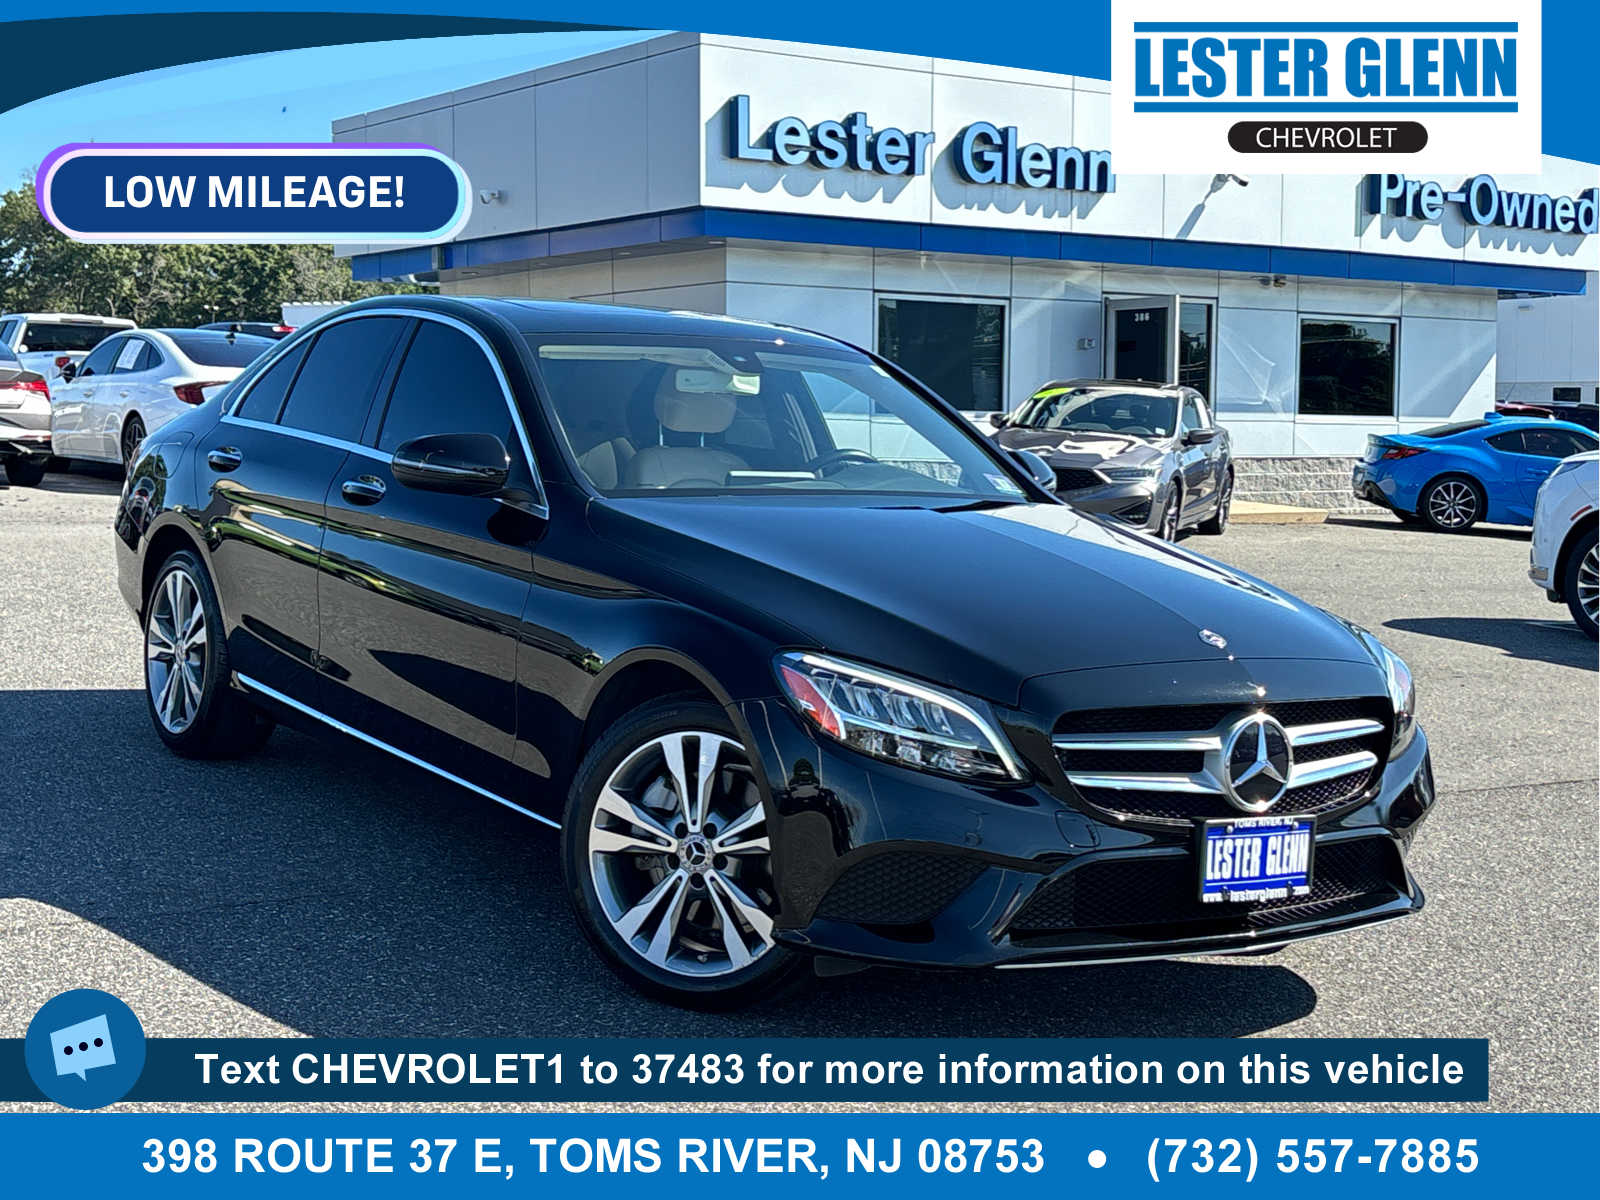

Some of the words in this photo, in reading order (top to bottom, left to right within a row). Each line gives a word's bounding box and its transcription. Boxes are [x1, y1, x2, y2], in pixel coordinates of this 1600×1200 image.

[732, 94, 935, 176] Lester
[956, 121, 1116, 193] Glenn
[1370, 174, 1599, 234] Pre-Owned
[1206, 837, 1262, 880] LESTER
[1265, 833, 1310, 876] GLENN
